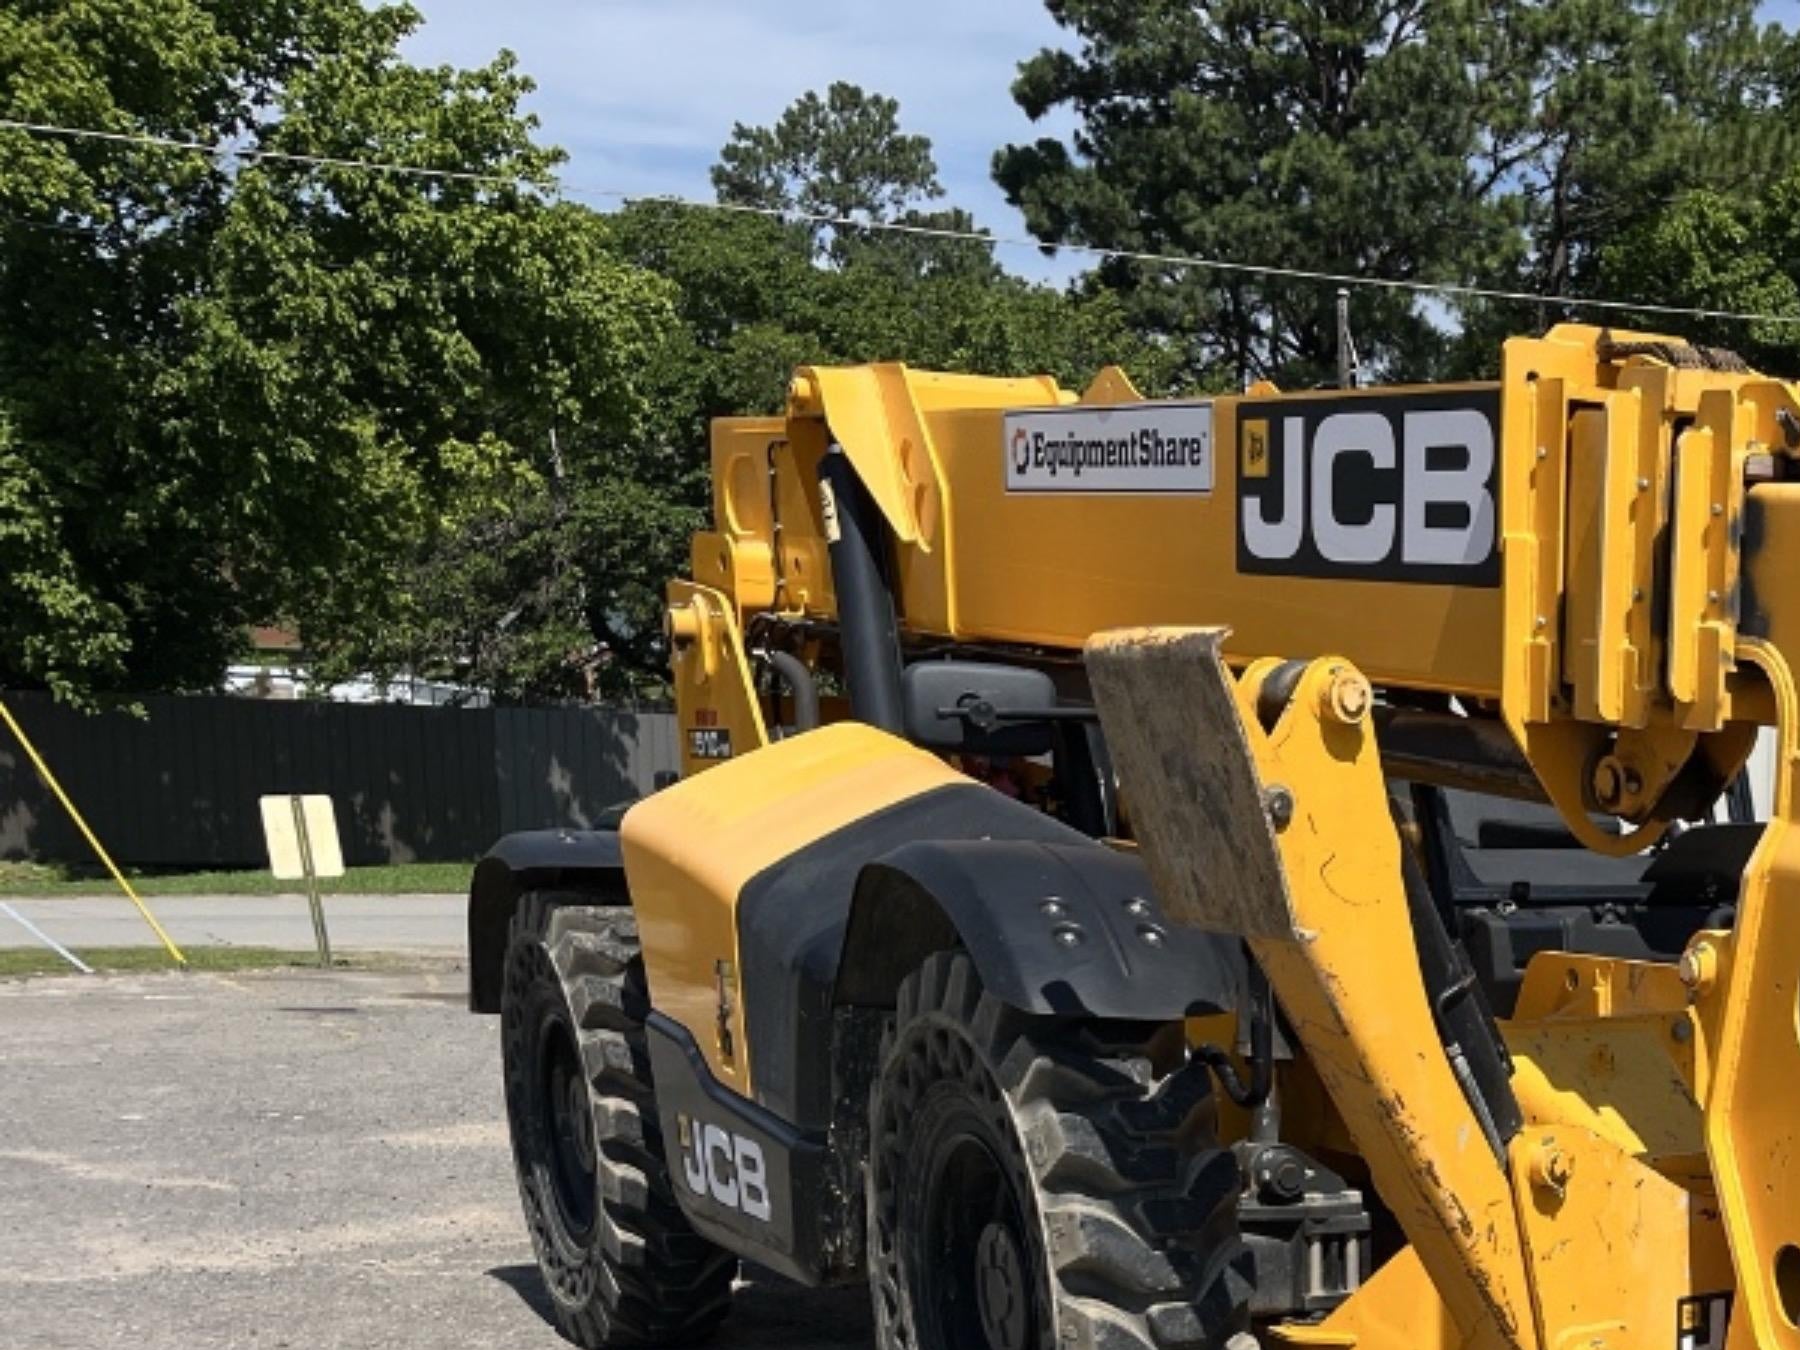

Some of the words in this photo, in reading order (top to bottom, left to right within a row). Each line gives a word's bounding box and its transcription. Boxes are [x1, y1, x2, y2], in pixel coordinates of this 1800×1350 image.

[1032, 428, 1202, 477] EquipmentShare
[1242, 409, 1495, 565] JCB
[683, 1118, 771, 1221] JCB
